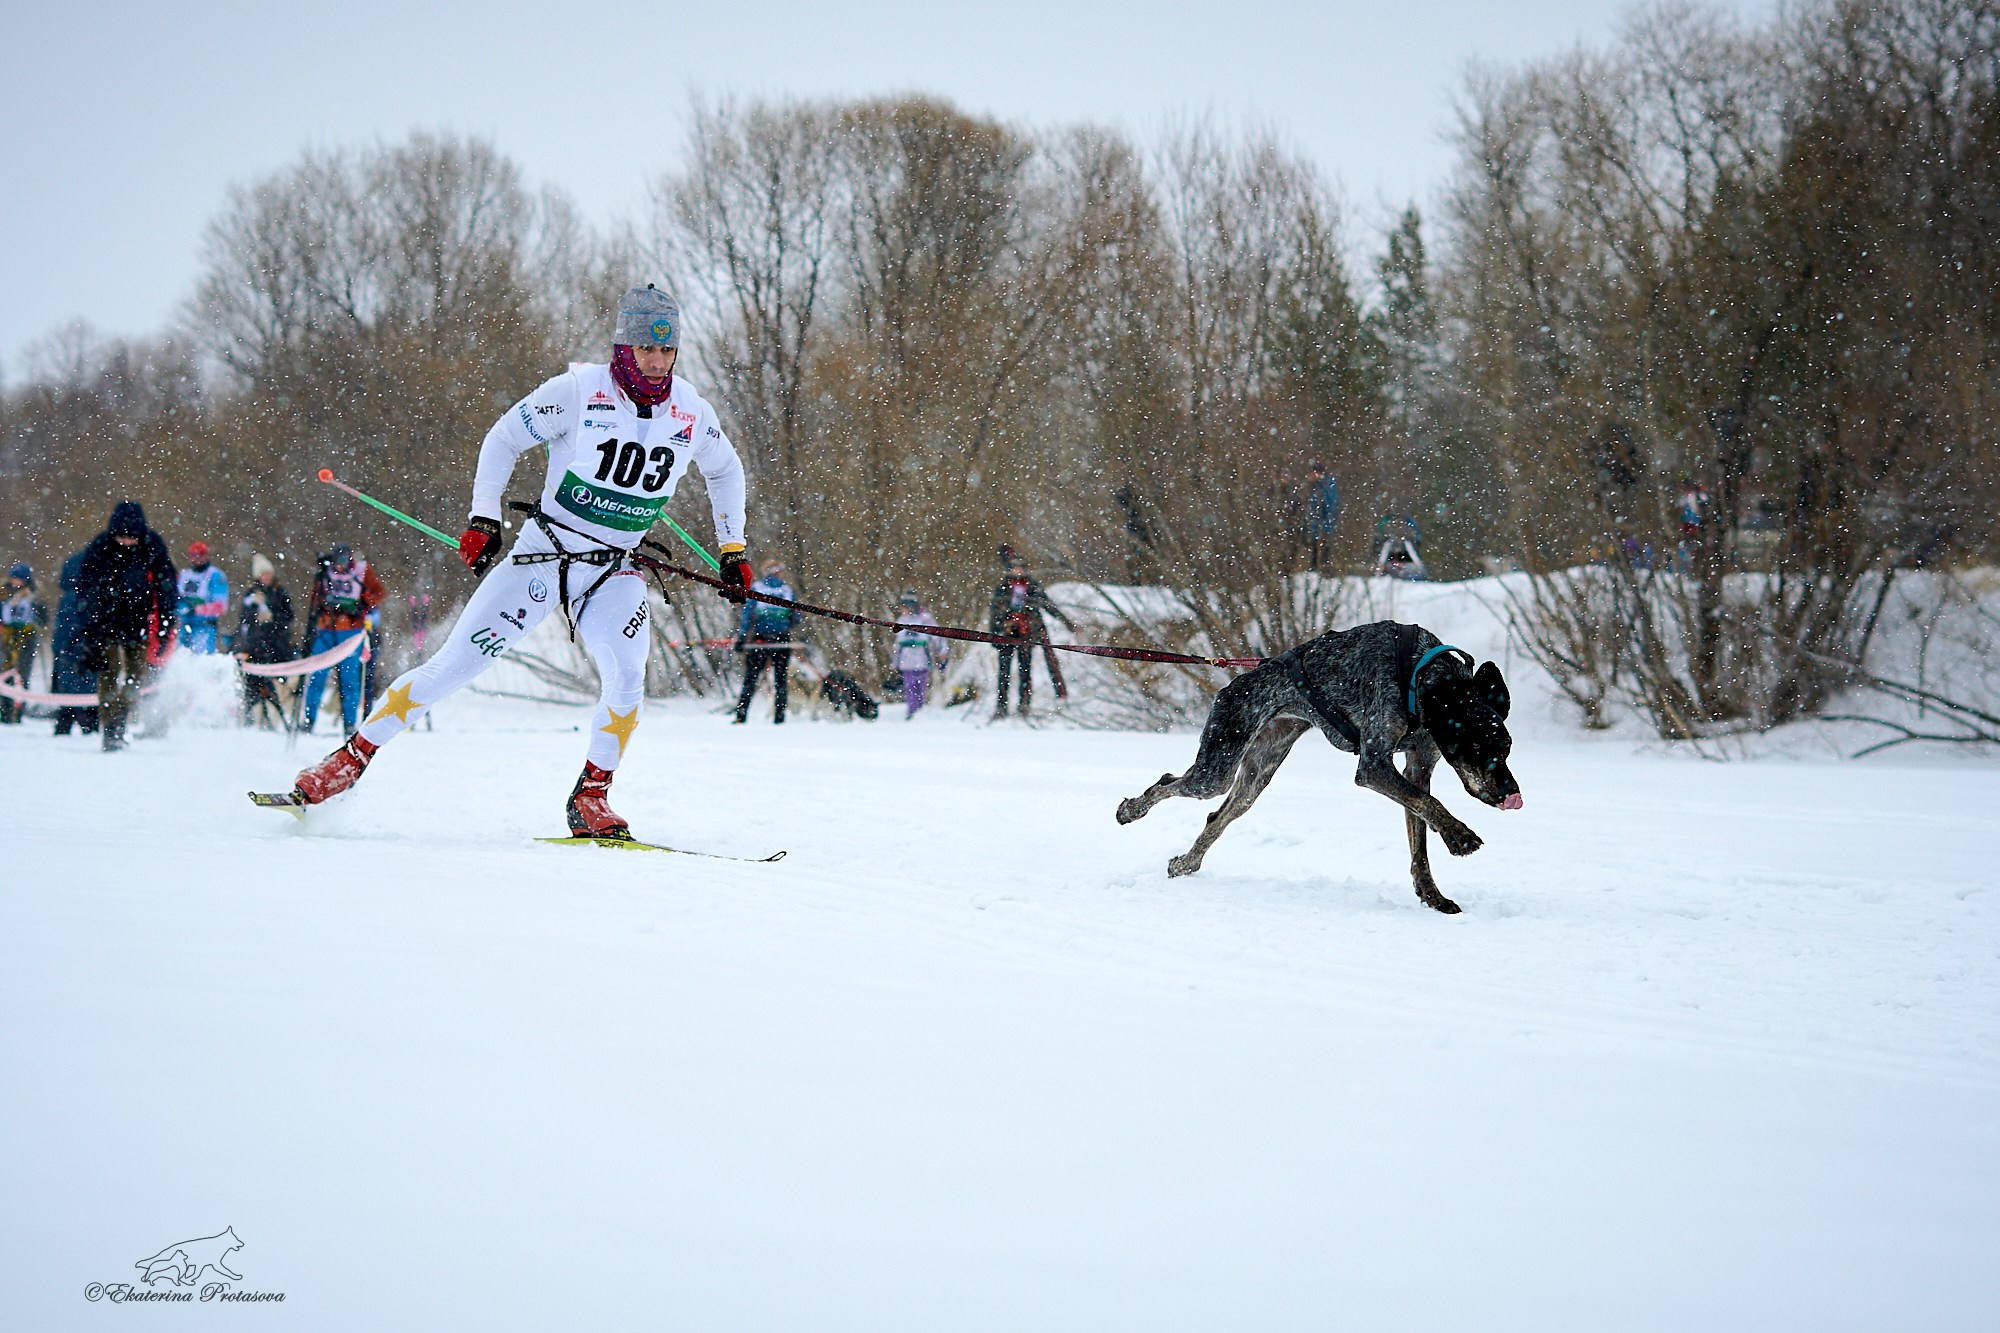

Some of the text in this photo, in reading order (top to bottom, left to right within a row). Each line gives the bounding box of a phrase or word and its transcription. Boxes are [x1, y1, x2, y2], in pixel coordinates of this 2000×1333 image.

[594, 437, 675, 493] 103
[593, 496, 658, 517] МЕГАФОН
[594, 839, 625, 848] SCHER
